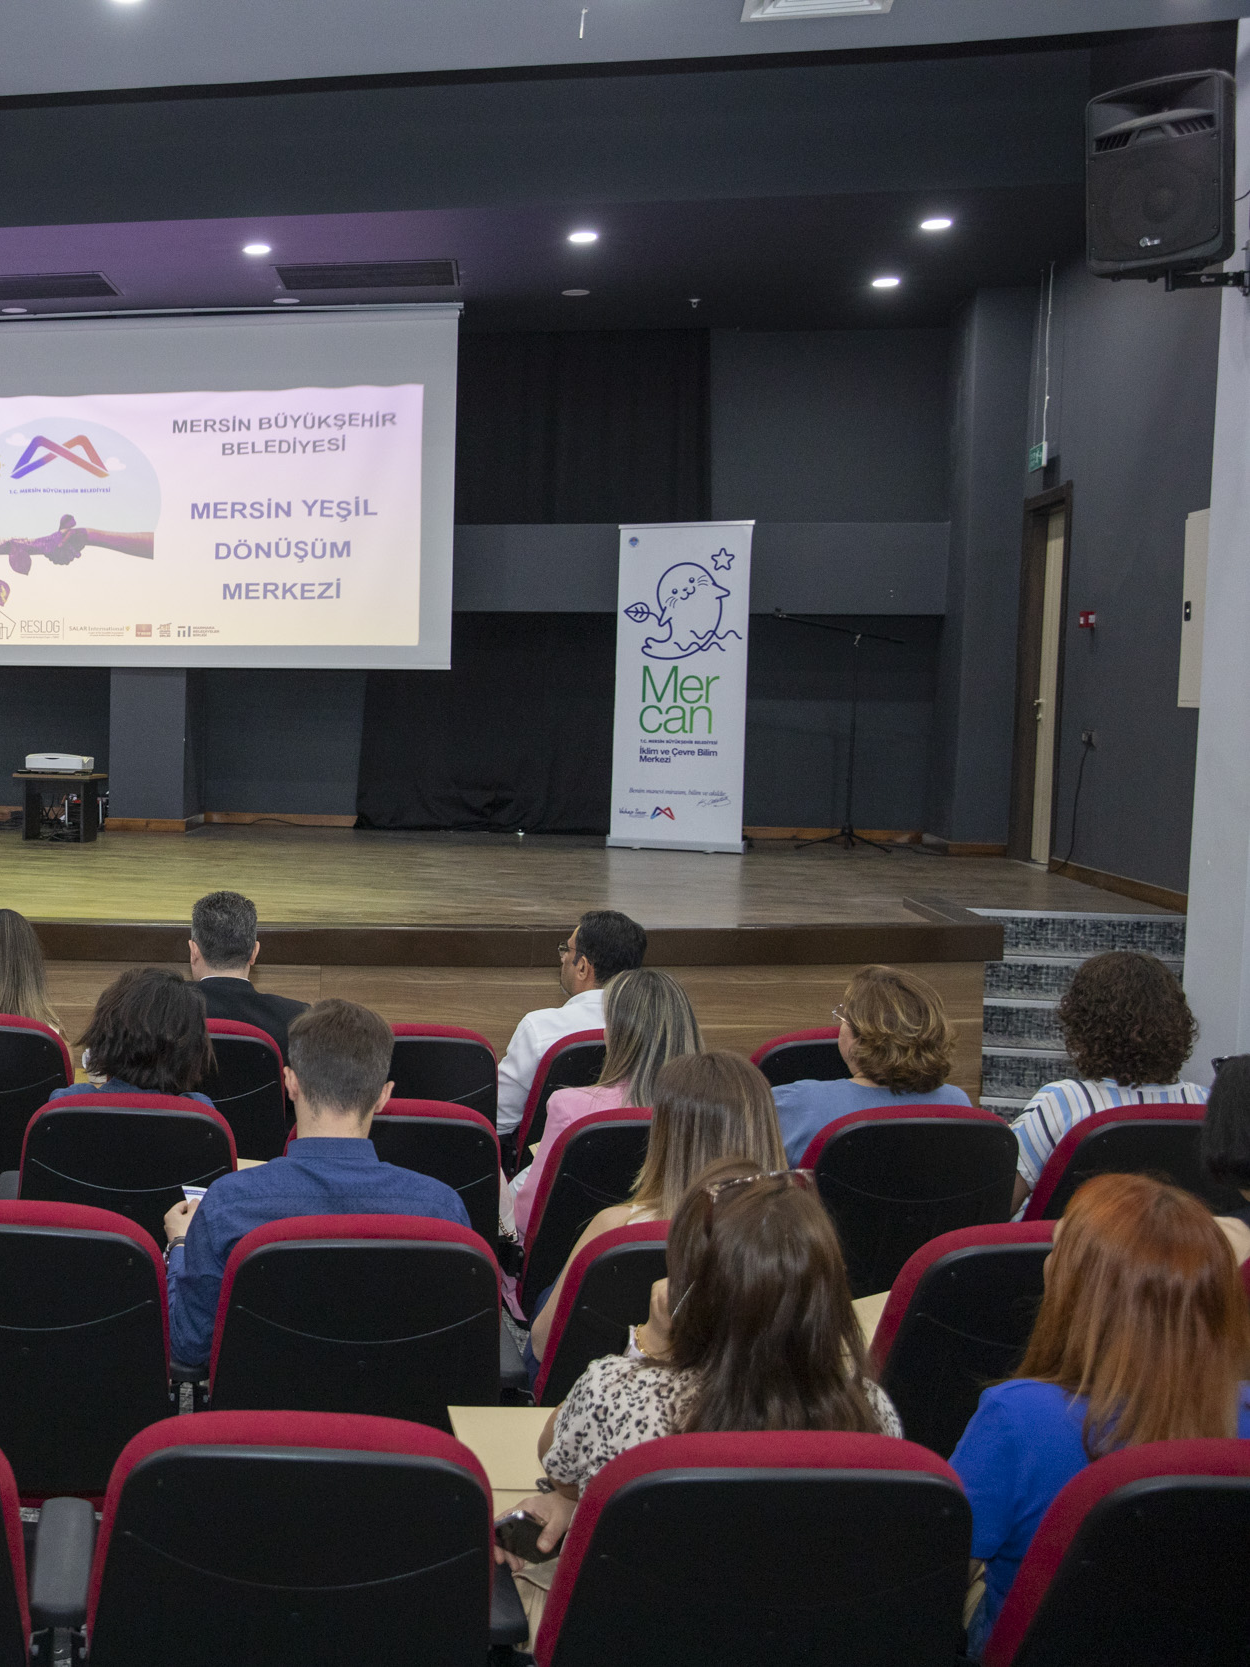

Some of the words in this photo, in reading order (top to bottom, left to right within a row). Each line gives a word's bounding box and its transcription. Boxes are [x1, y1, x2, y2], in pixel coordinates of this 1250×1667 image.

[172, 415, 251, 434] MERSİN
[258, 411, 398, 431] BÜYÜKŞEHİR
[221, 434, 346, 456] BELEDİYESİ
[190, 498, 292, 520] MERSİN
[301, 496, 378, 522] YEŞİL
[214, 537, 351, 563] DÖNÜŞÜM
[222, 578, 341, 600] MERKEZİ
[20, 620, 60, 633] RESLOG
[641, 665, 720, 704] Mer
[639, 704, 713, 734] can
[639, 745, 659, 755] İklim
[671, 747, 696, 757] Çevre
[697, 748, 718, 757] Bilim
[639, 755, 672, 764] Merkezi
